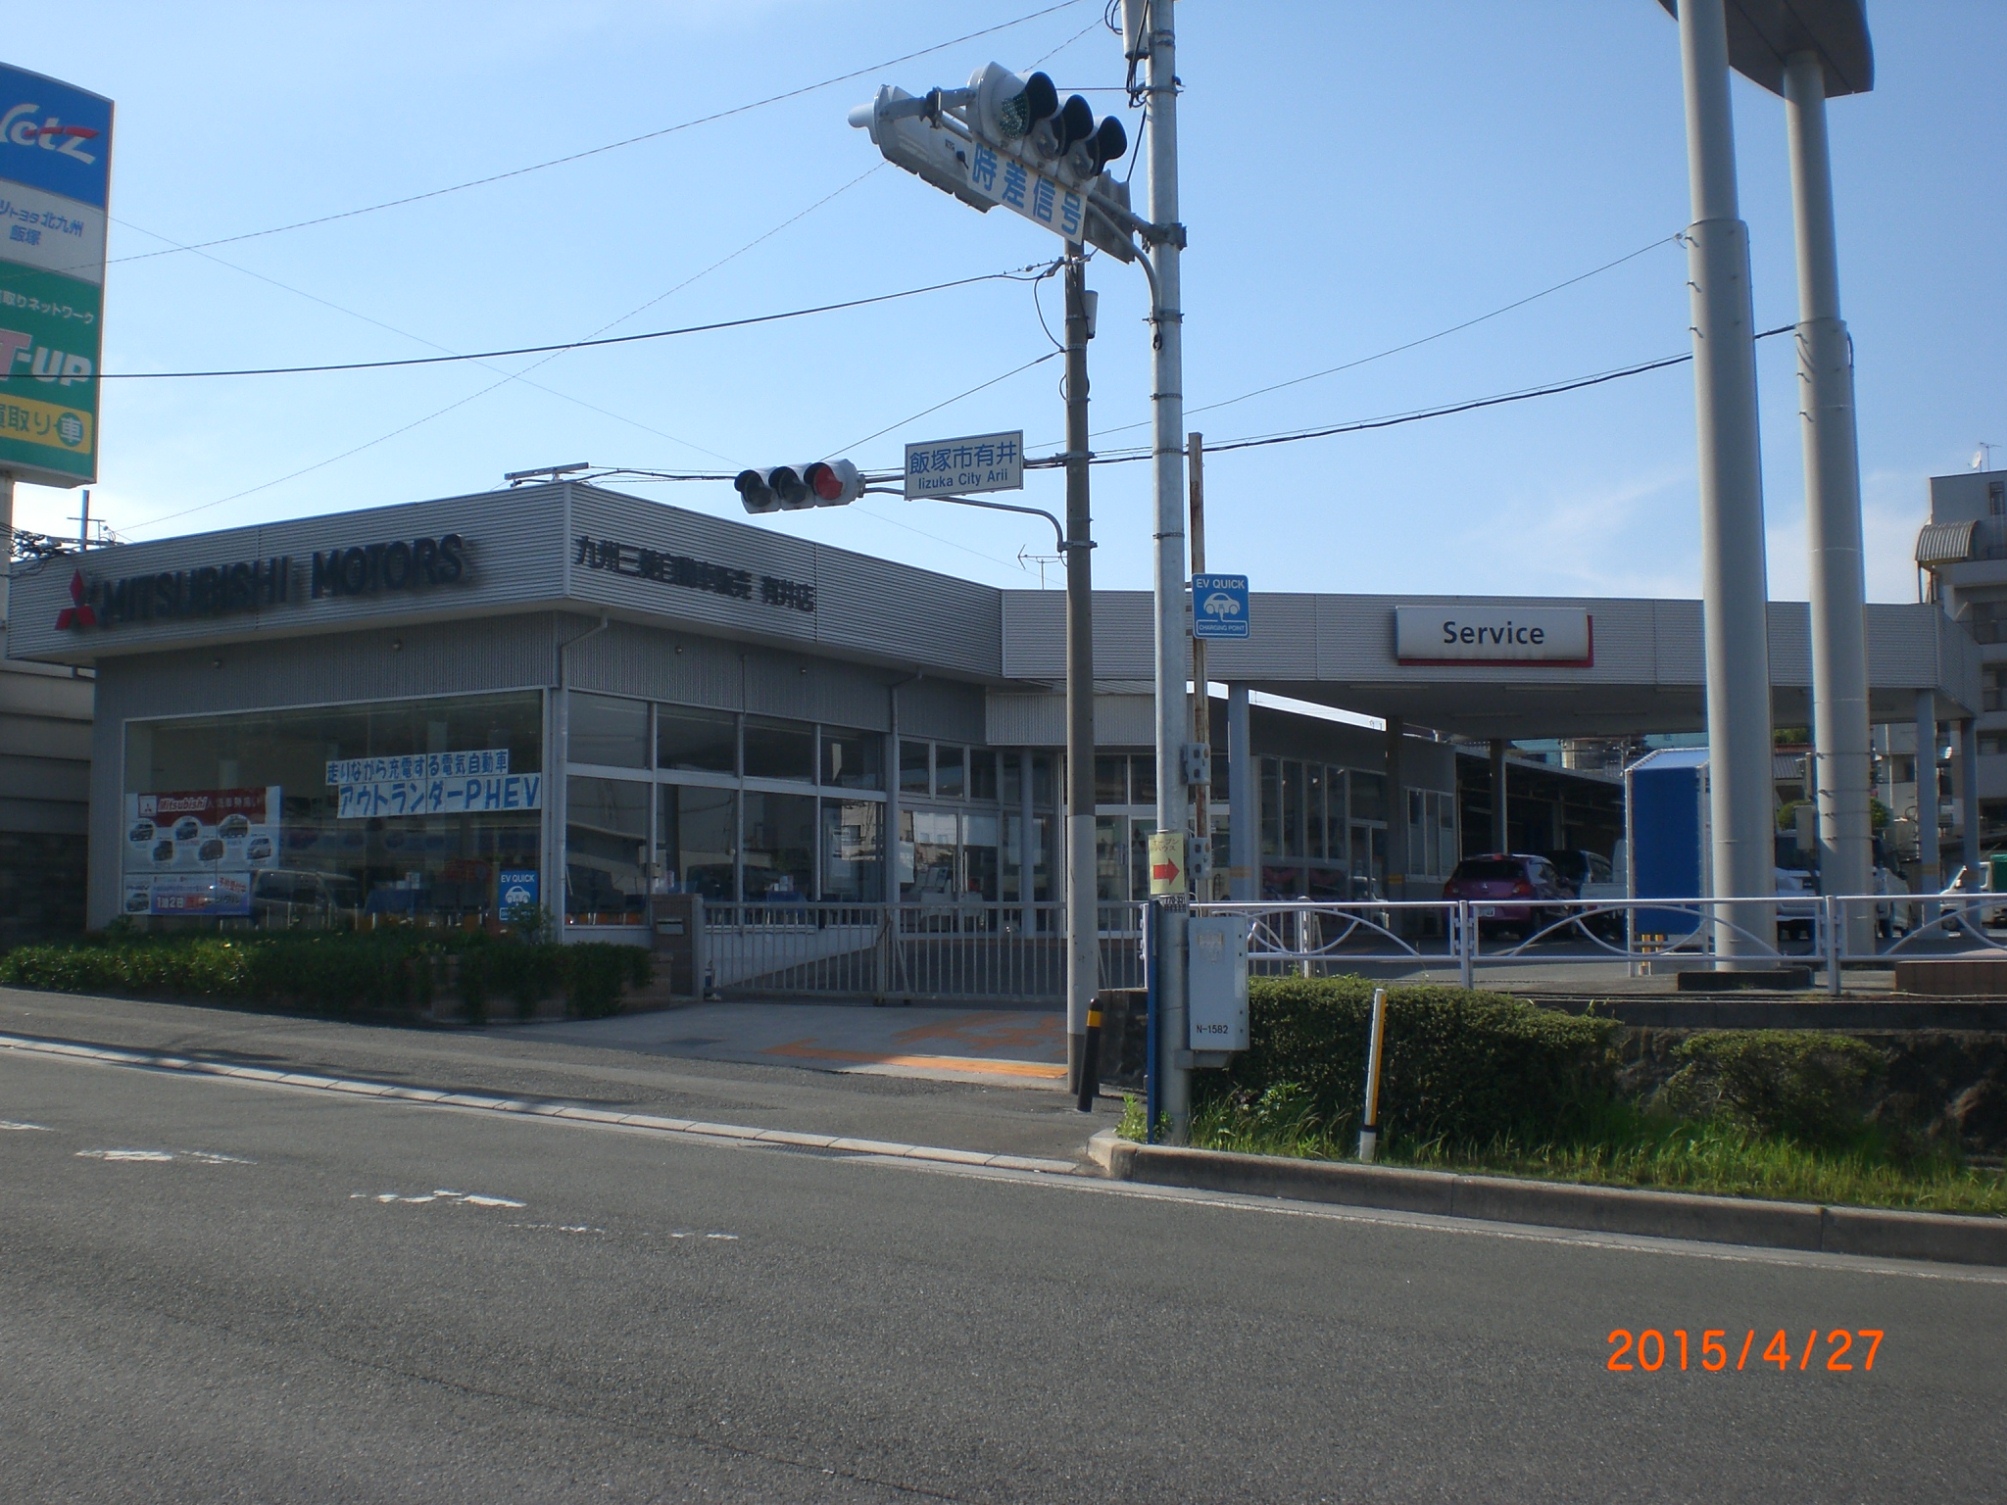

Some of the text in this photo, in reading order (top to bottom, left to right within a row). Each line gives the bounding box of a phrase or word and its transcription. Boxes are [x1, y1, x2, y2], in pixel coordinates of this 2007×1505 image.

[972, 142, 1082, 235] 時差信号
[9, 224, 42, 246] 飯塚
[0, 289, 94, 324] 取りネットワーク
[909, 440, 1017, 475] 飯塚市有井
[918, 468, 1008, 490] Iizuka City Arii
[101, 533, 465, 625] MITSUBISHI MOTORS
[760, 575, 816, 612] 有井店
[1196, 578, 1245, 589] EV QUICK
[1442, 620, 1545, 645] Service
[327, 751, 507, 783] 走りながら充電する電気自動車
[339, 776, 540, 816] アウトランダーPHEV
[501, 873, 535, 883] EV QUICK
[1196, 1025, 1229, 1034] N-1582
